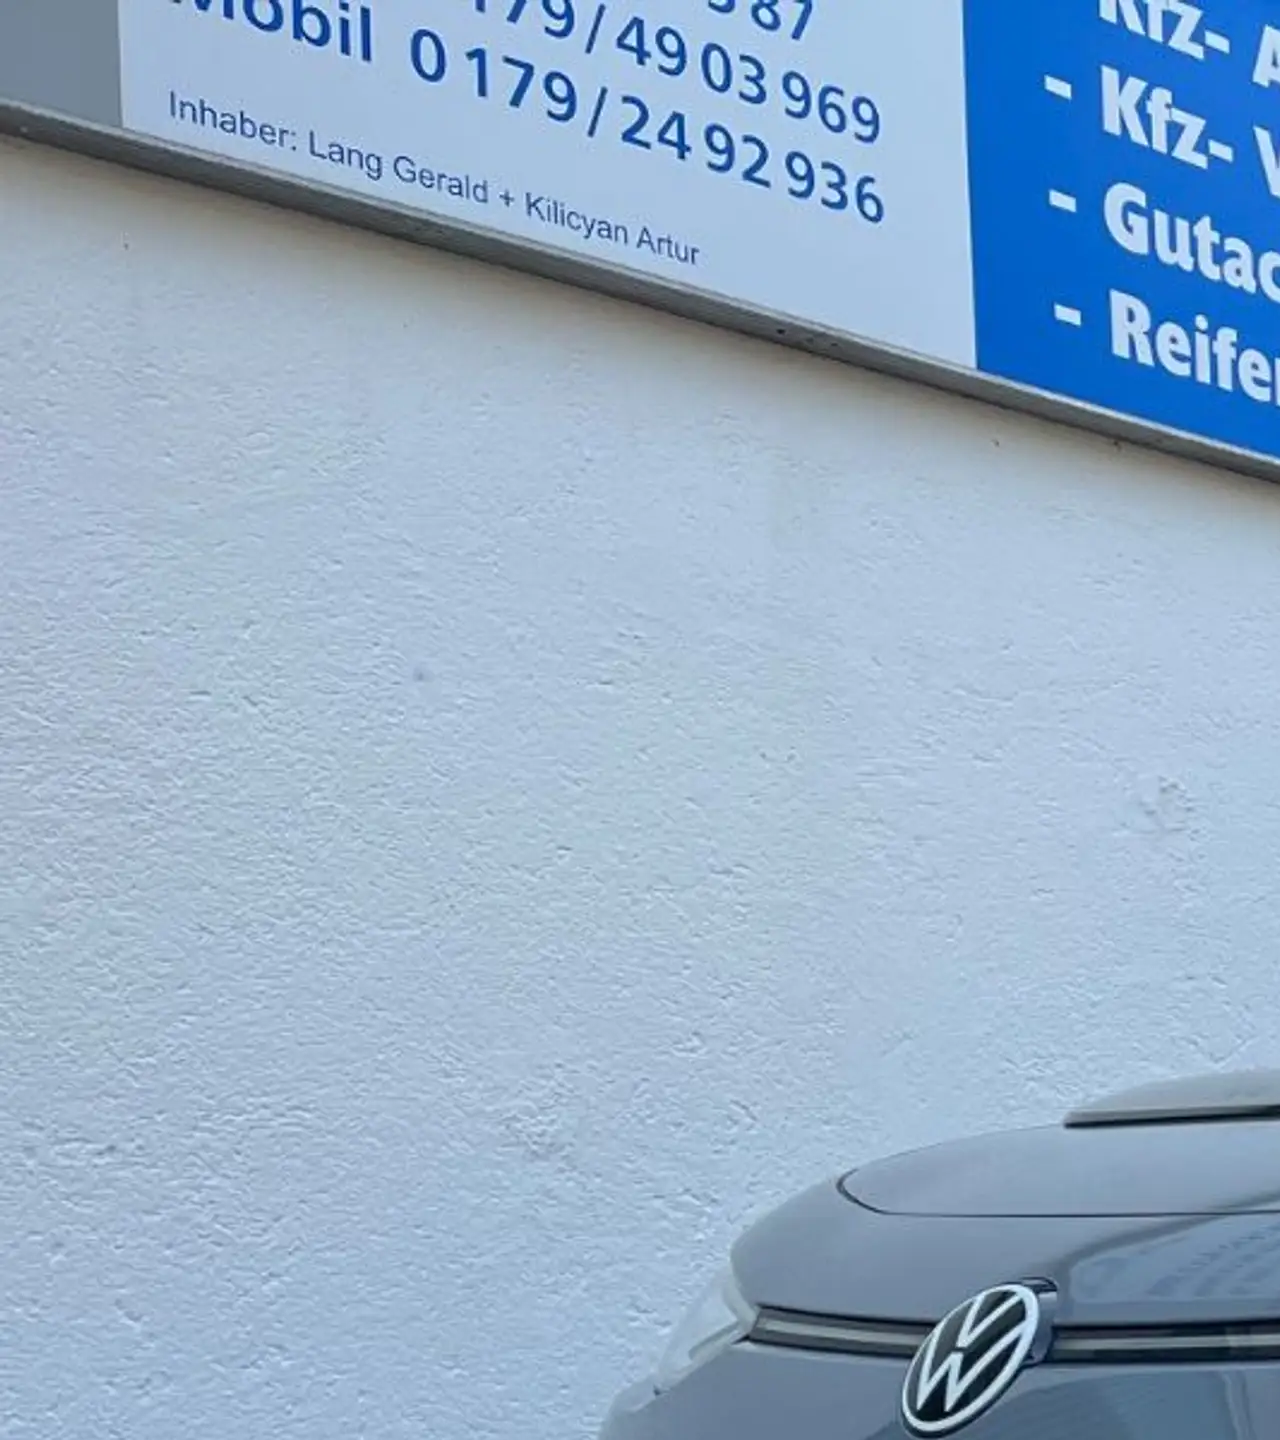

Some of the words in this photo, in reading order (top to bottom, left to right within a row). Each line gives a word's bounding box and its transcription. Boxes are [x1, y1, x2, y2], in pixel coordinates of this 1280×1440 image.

[169, 91, 297, 152] Inhaber:
[309, 130, 382, 181] Lang
[393, 155, 488, 204] Gerald
[525, 192, 629, 244] Kilicyan
[637, 227, 700, 266] Artur
[1101, 65, 1233, 169] Kfz-
